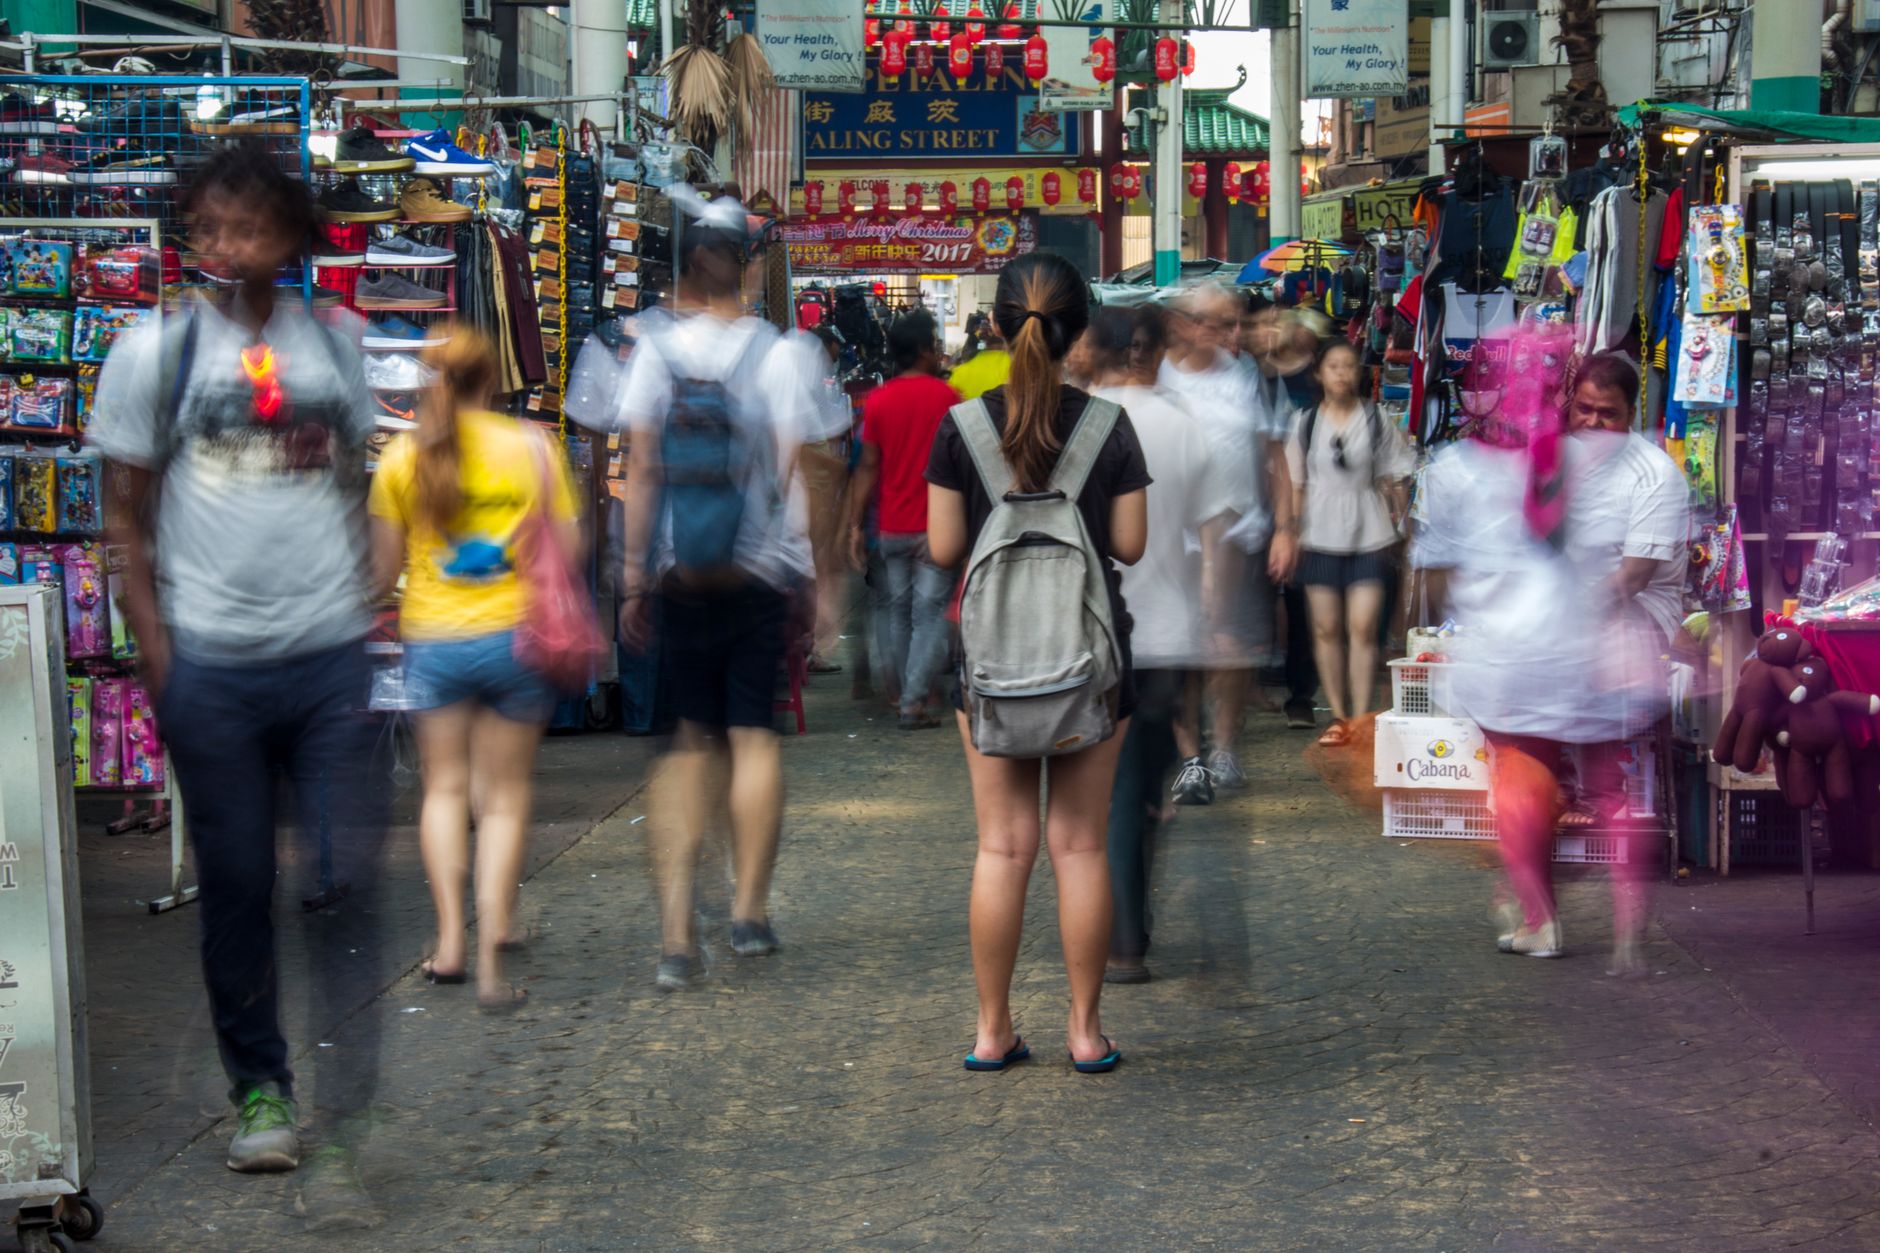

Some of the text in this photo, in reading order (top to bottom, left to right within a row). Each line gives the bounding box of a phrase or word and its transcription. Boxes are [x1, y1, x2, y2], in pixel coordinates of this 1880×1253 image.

[764, 34, 838, 46] Your Health,
[800, 50, 817, 62] My
[821, 49, 853, 62] Glory
[1312, 44, 1383, 56] Your Health,
[1345, 60, 1362, 71] My
[1365, 58, 1397, 70] Glory
[1312, 81, 1407, 93] www.zhen-ao.com.my
[900, 129, 1000, 148] STREET
[847, 217, 973, 244] Merry Christmas
[921, 243, 973, 262] 2017
[1407, 758, 1471, 781] Cabana
